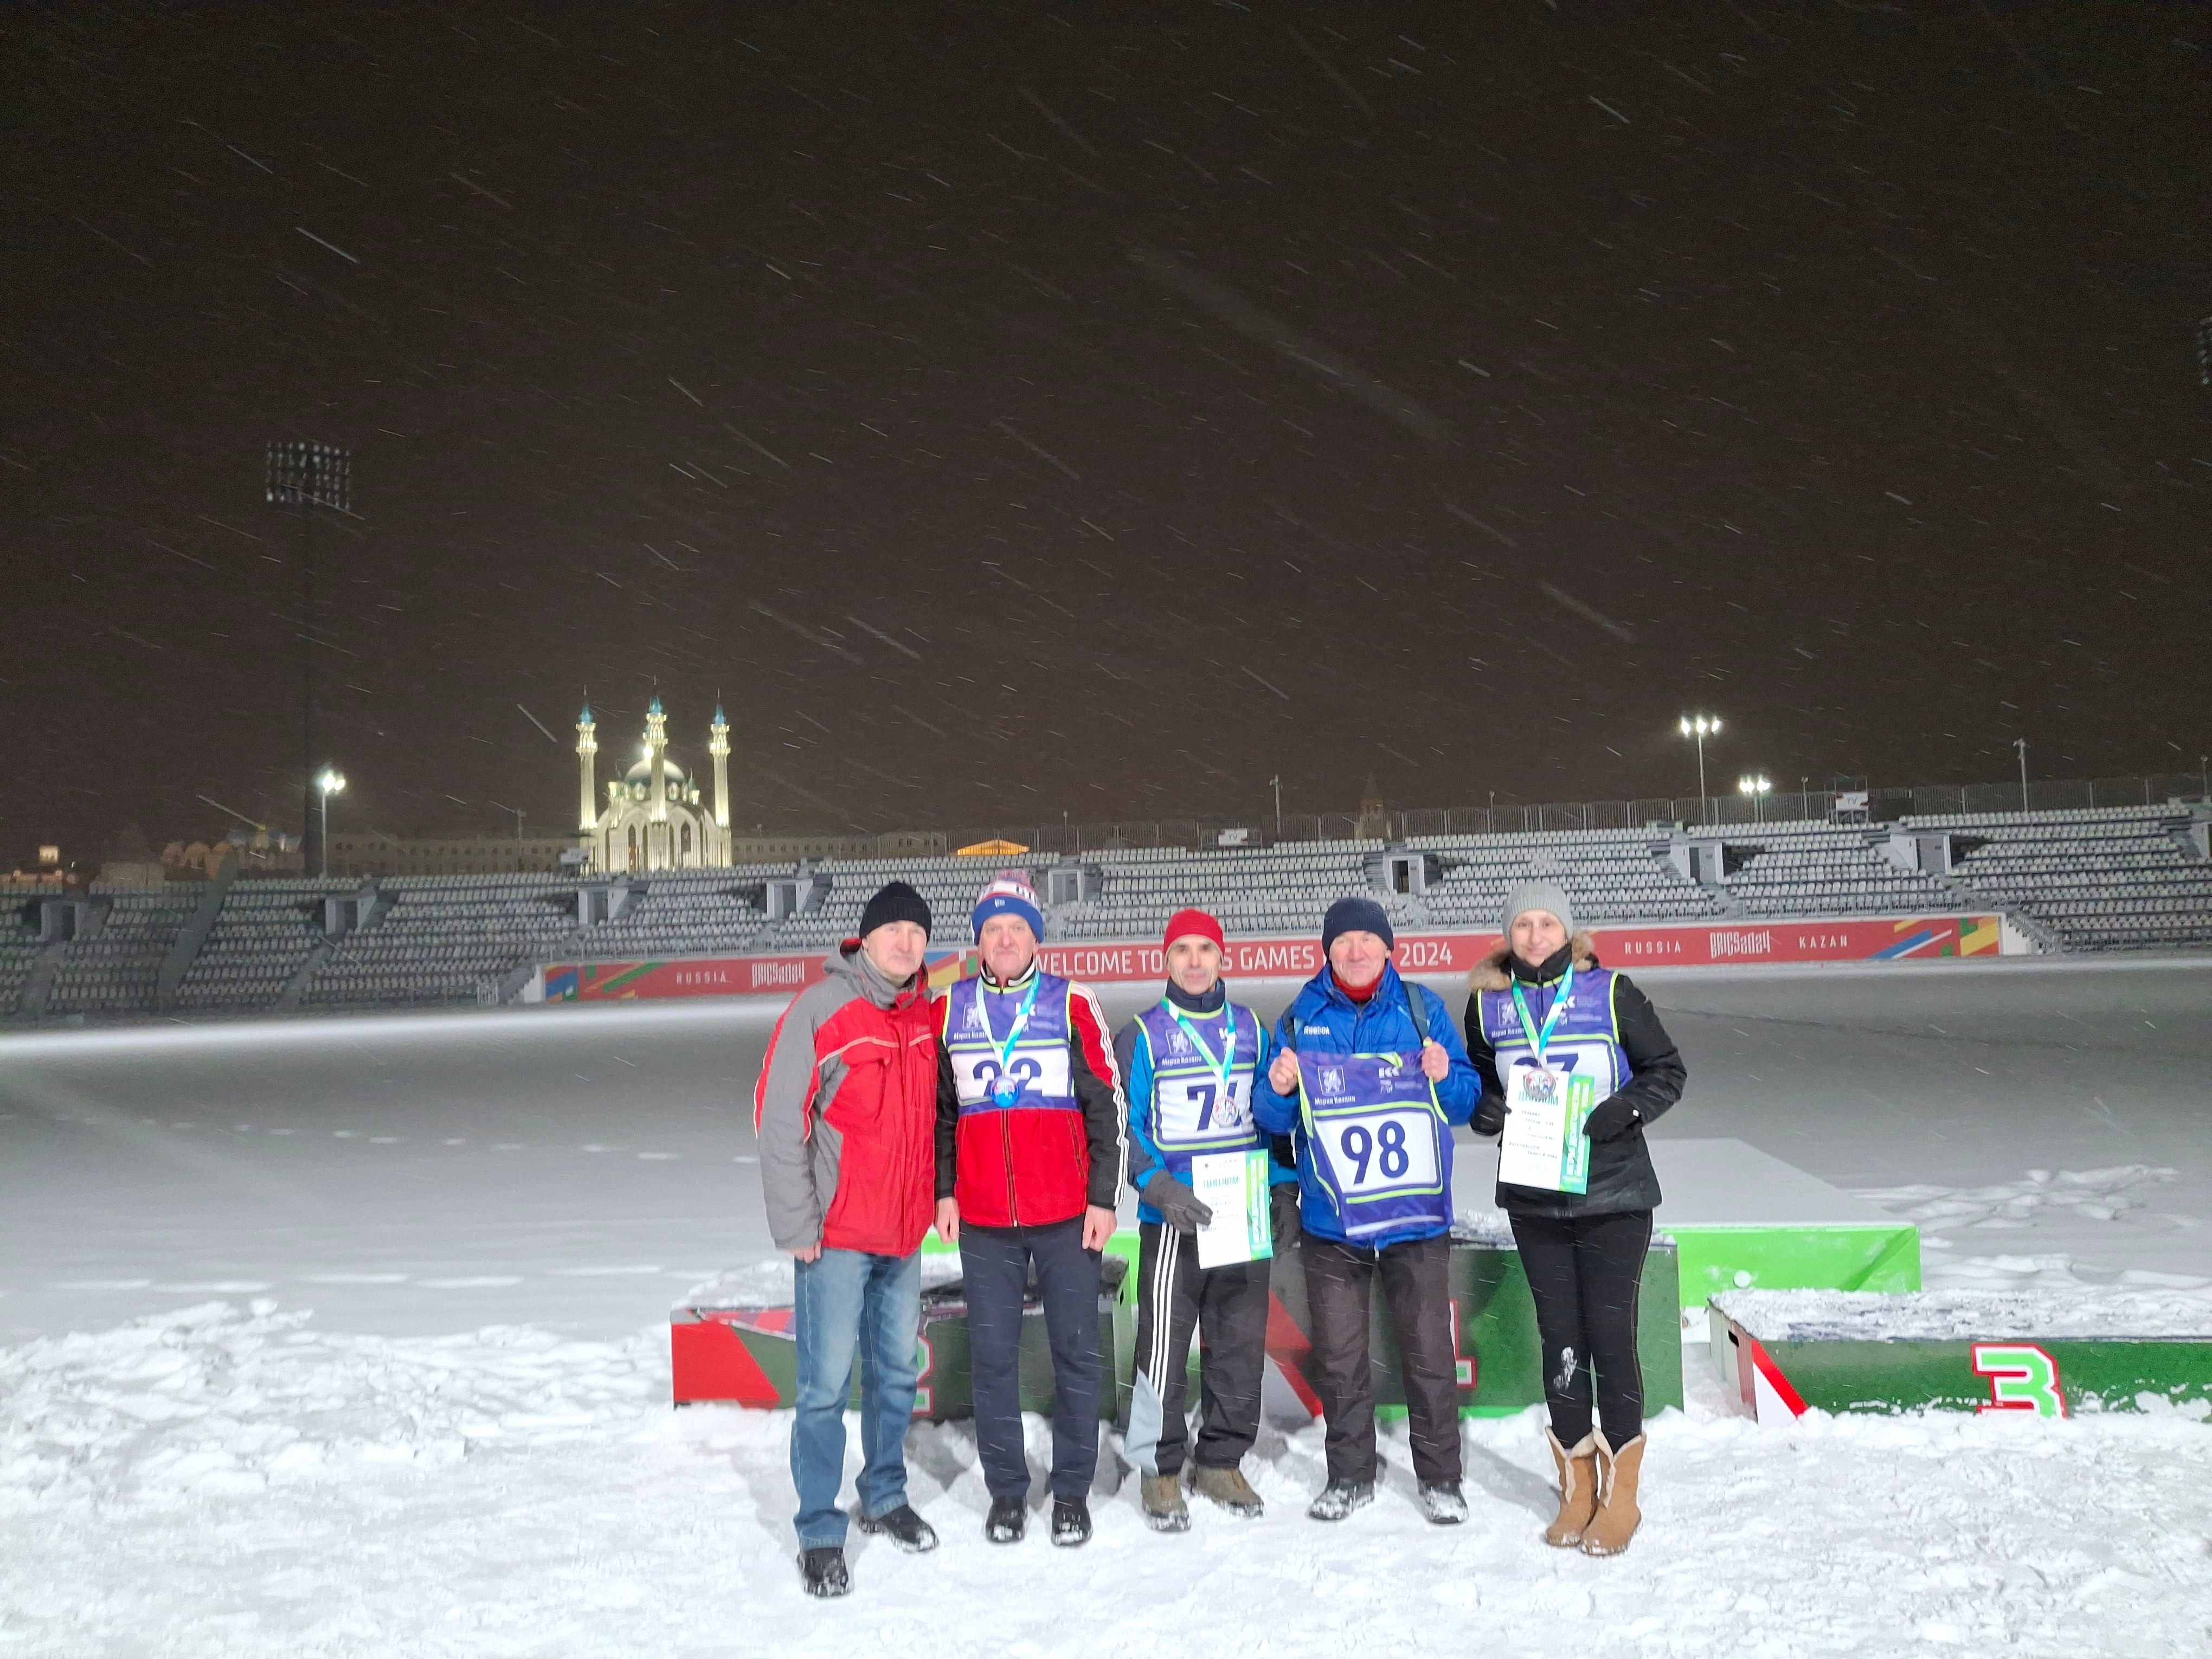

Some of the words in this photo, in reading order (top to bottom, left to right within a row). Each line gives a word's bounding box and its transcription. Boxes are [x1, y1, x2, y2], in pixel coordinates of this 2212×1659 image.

[1137, 949, 1163, 974] TO
[1240, 945, 1315, 971] GAMES
[1399, 941, 1452, 967] 2024
[1625, 940, 1681, 955] RUSSIA
[1799, 935, 1847, 949] KAZAN
[676, 970, 726, 986] RUSSIA
[1341, 1121, 1409, 1186] 98
[1971, 1343, 2067, 1419] 3
